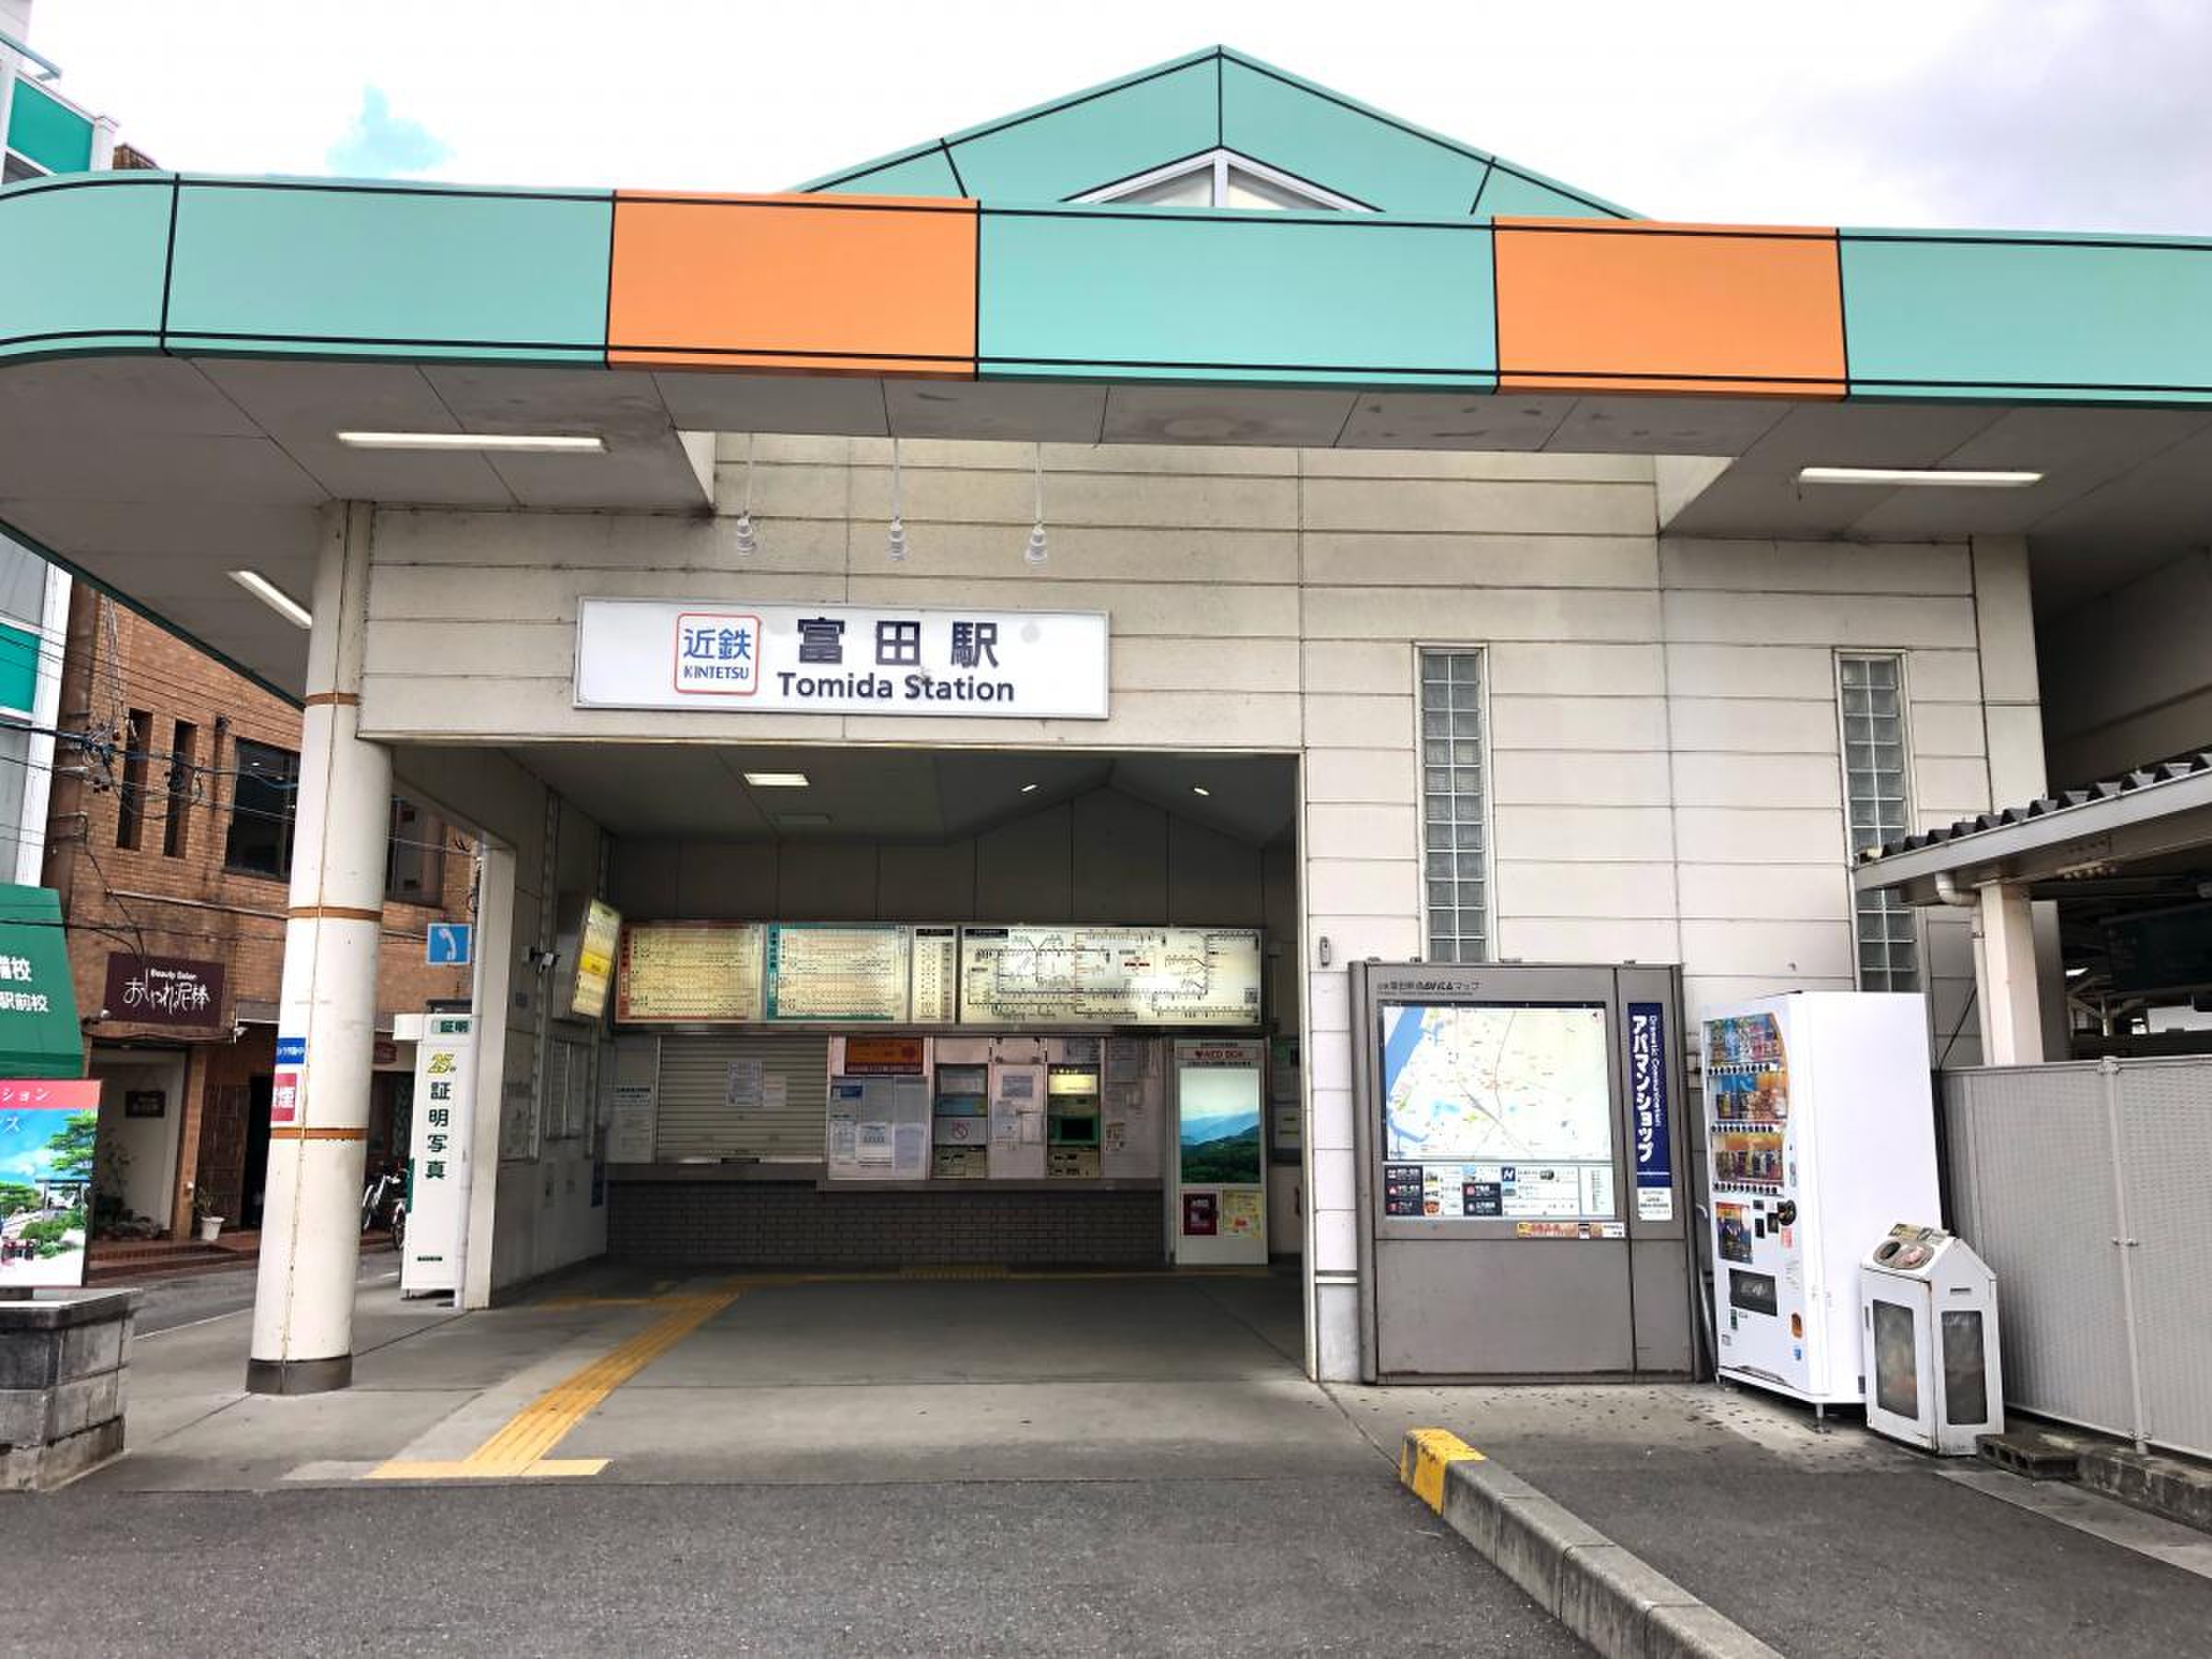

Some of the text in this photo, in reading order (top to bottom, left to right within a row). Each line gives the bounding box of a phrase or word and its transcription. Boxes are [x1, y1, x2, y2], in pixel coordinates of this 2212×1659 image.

[682, 628, 752, 662] 近鉄
[797, 617, 1000, 669] 富田駅
[683, 665, 749, 680] KINTETSU
[777, 672, 1015, 702] Tomida Station
[1631, 1015, 1654, 1163] アパマンショップ
[425, 1081, 452, 1181] 証明写真
